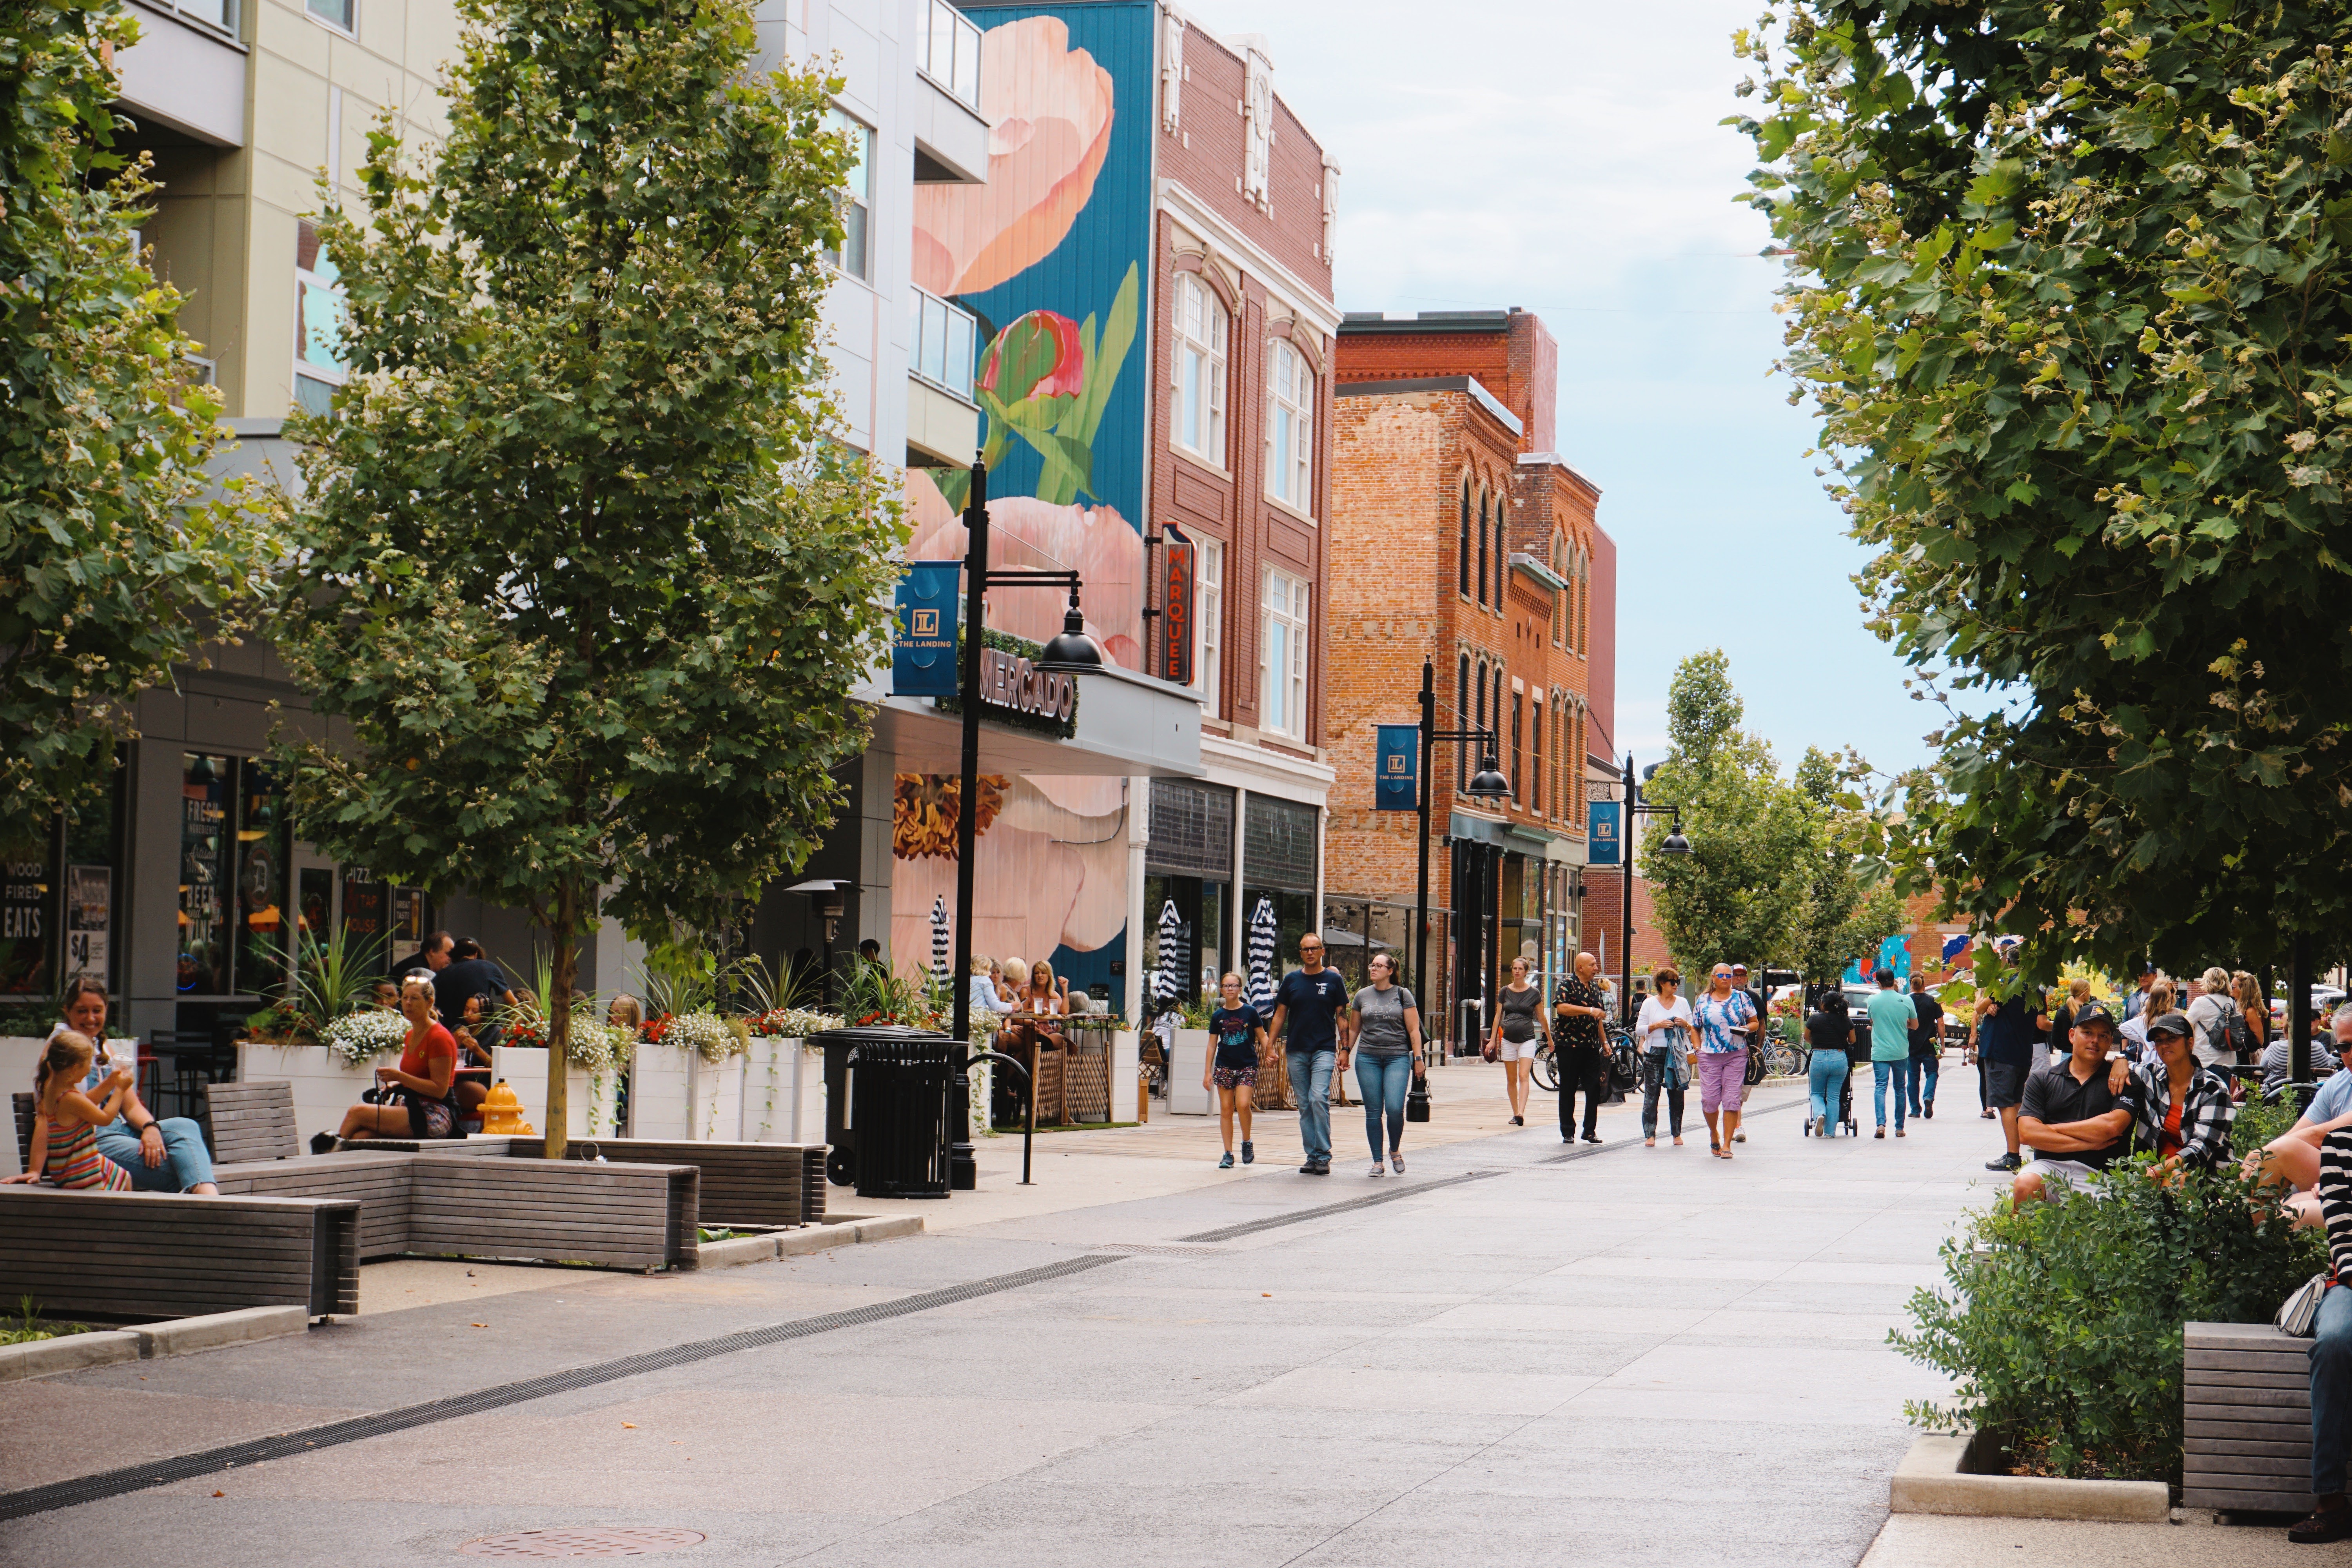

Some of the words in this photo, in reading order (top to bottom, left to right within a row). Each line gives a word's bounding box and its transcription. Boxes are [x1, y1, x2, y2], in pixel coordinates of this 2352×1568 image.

[1167, 550, 1185, 676] MARQUEE
[980, 647, 1074, 722] MERCADO
[188, 800, 220, 823] FRESH
[6, 862, 42, 877] WOOD
[347, 867, 377, 884] PIZZ
[5, 884, 41, 899] FIRED
[187, 884, 215, 907] BEER
[360, 894, 377, 909] TAP
[4, 907, 41, 937] EATS
[186, 919, 214, 942] WINE
